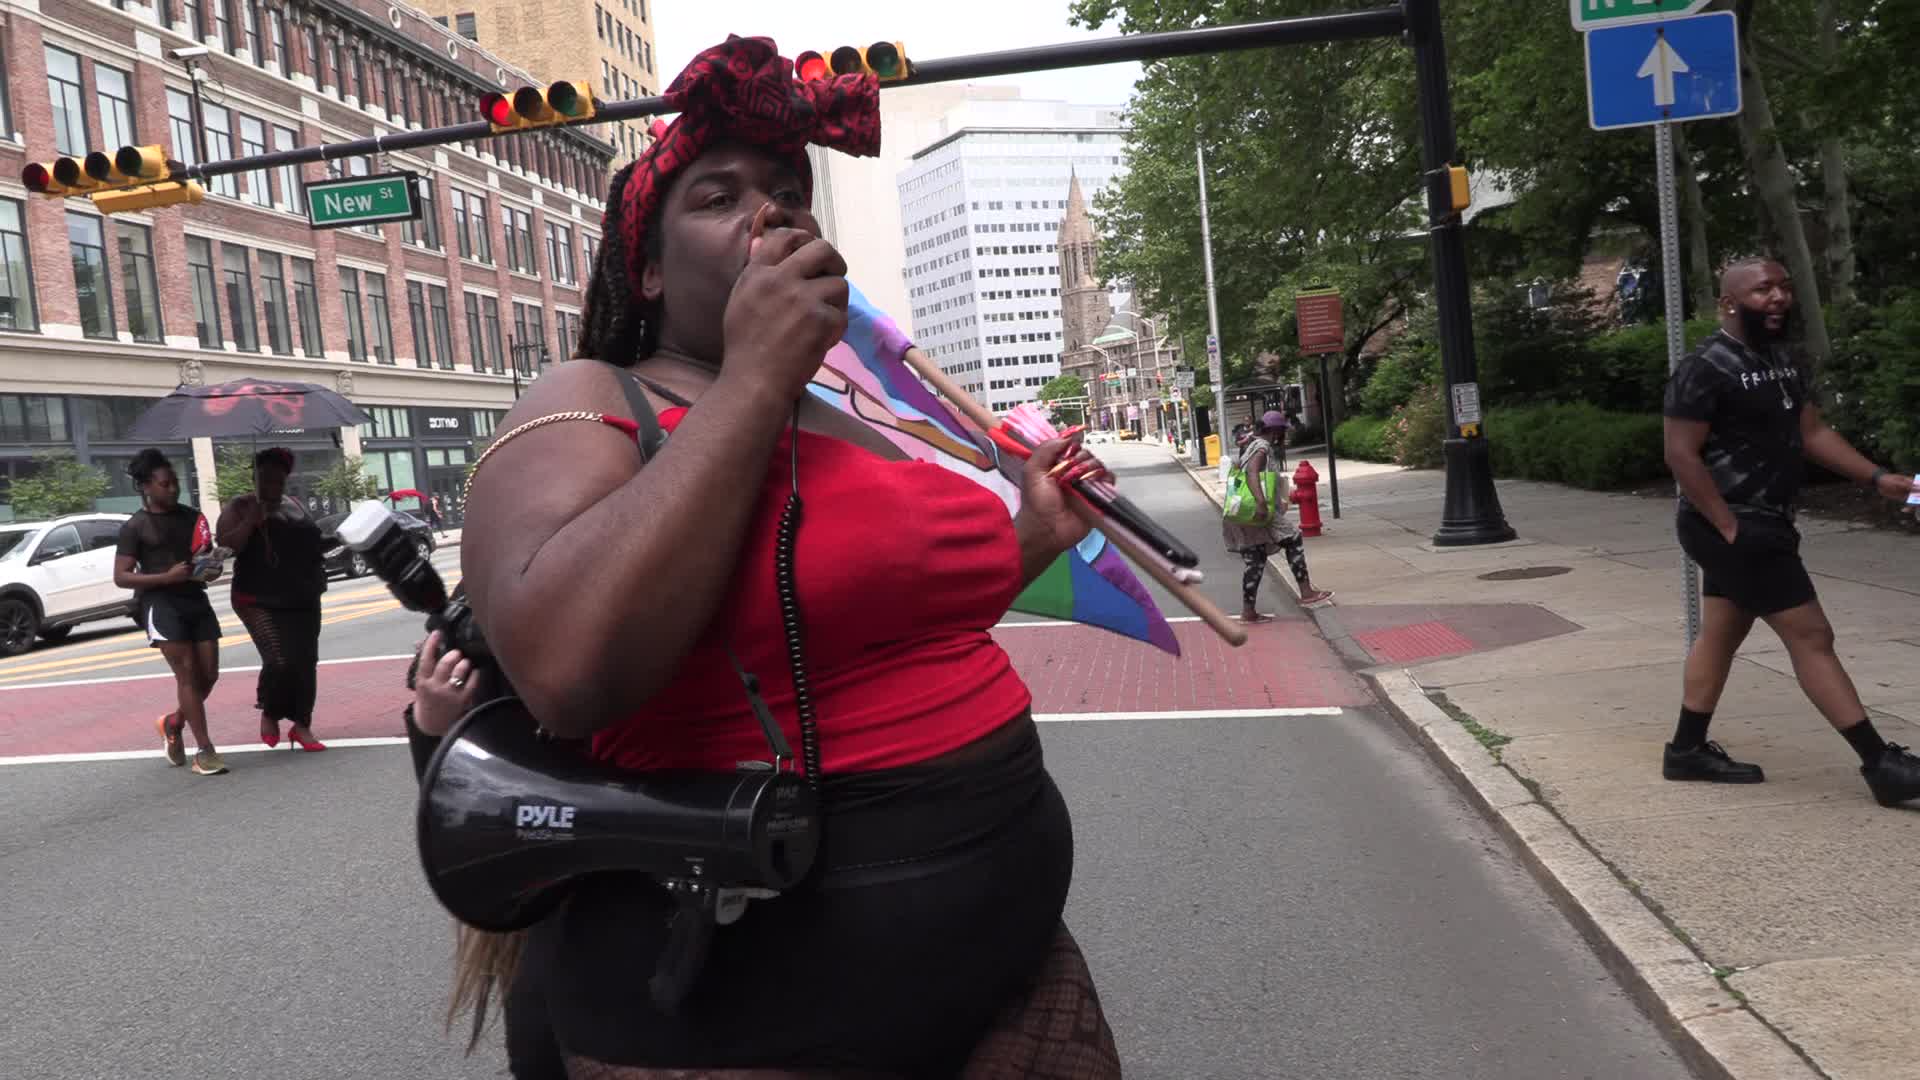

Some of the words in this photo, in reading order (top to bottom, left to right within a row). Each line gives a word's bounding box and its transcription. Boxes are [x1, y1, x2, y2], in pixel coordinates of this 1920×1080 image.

[324, 192, 372, 215] New
[380, 186, 393, 199] St
[517, 805, 575, 828] PYLE
